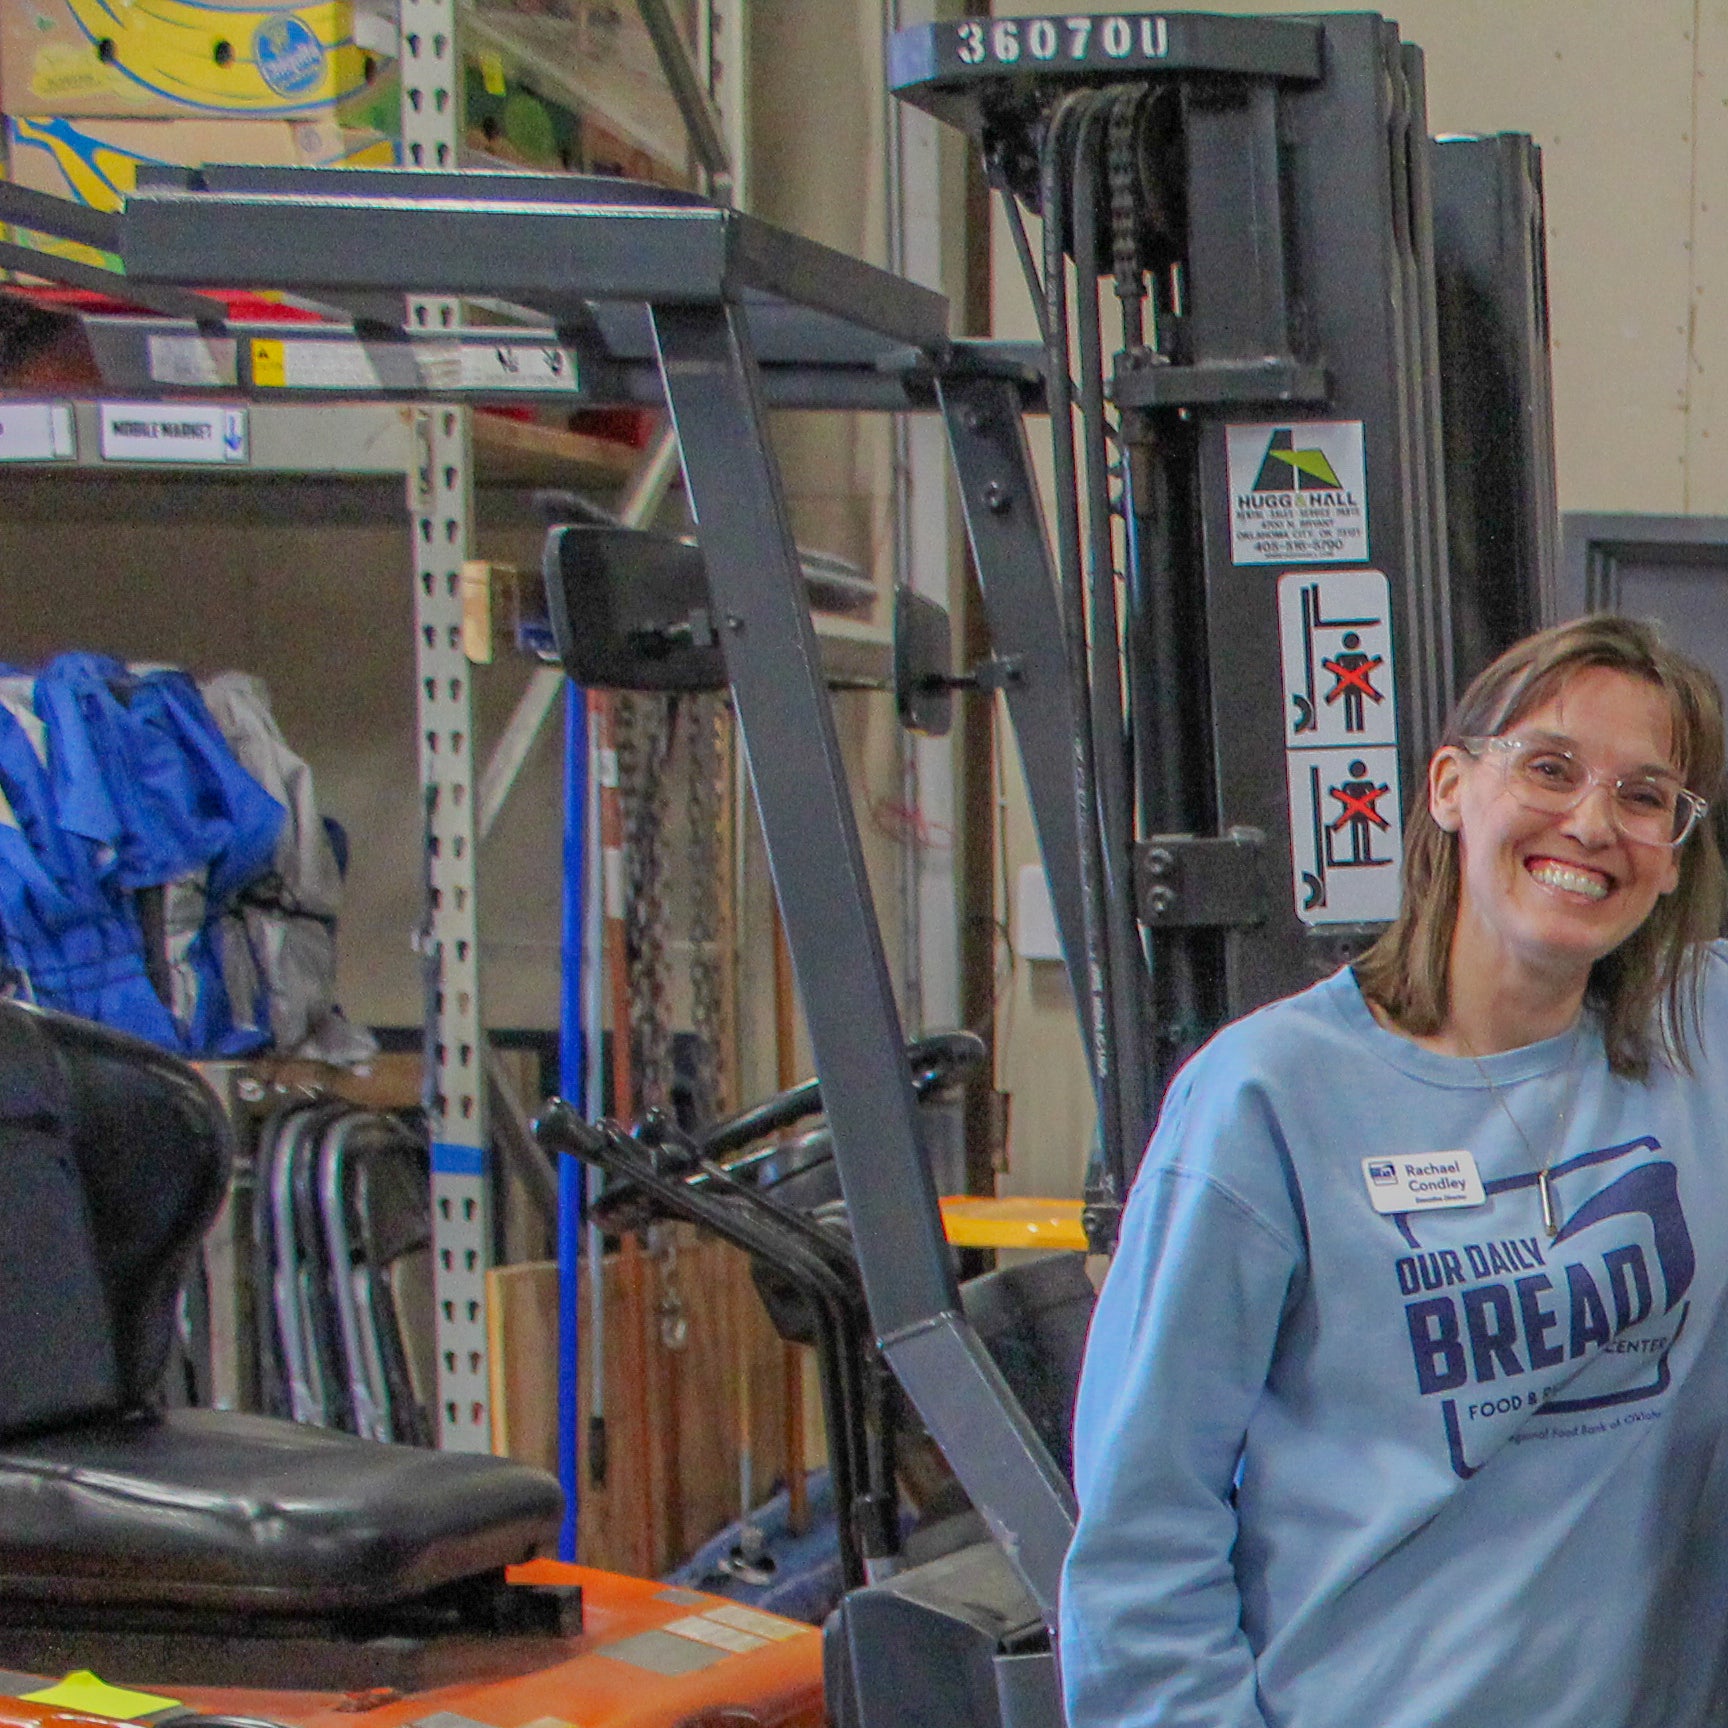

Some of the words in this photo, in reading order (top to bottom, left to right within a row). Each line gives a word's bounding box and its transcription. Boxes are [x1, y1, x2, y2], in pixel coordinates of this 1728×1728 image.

[957, 17, 1169, 64] 36070U
[161, 421, 212, 439] MARKET
[1238, 493, 1292, 508] HUGG
[1309, 491, 1357, 507] HALL
[1404, 1160, 1460, 1177] Rachael
[1408, 1177, 1466, 1192] Condley
[1395, 1248, 1466, 1297] OUR
[1463, 1236, 1547, 1282] DAILY
[1404, 1243, 1653, 1396] BREAD
[1468, 1395, 1523, 1421] FOOD
[1581, 1423, 1606, 1436] Bank
